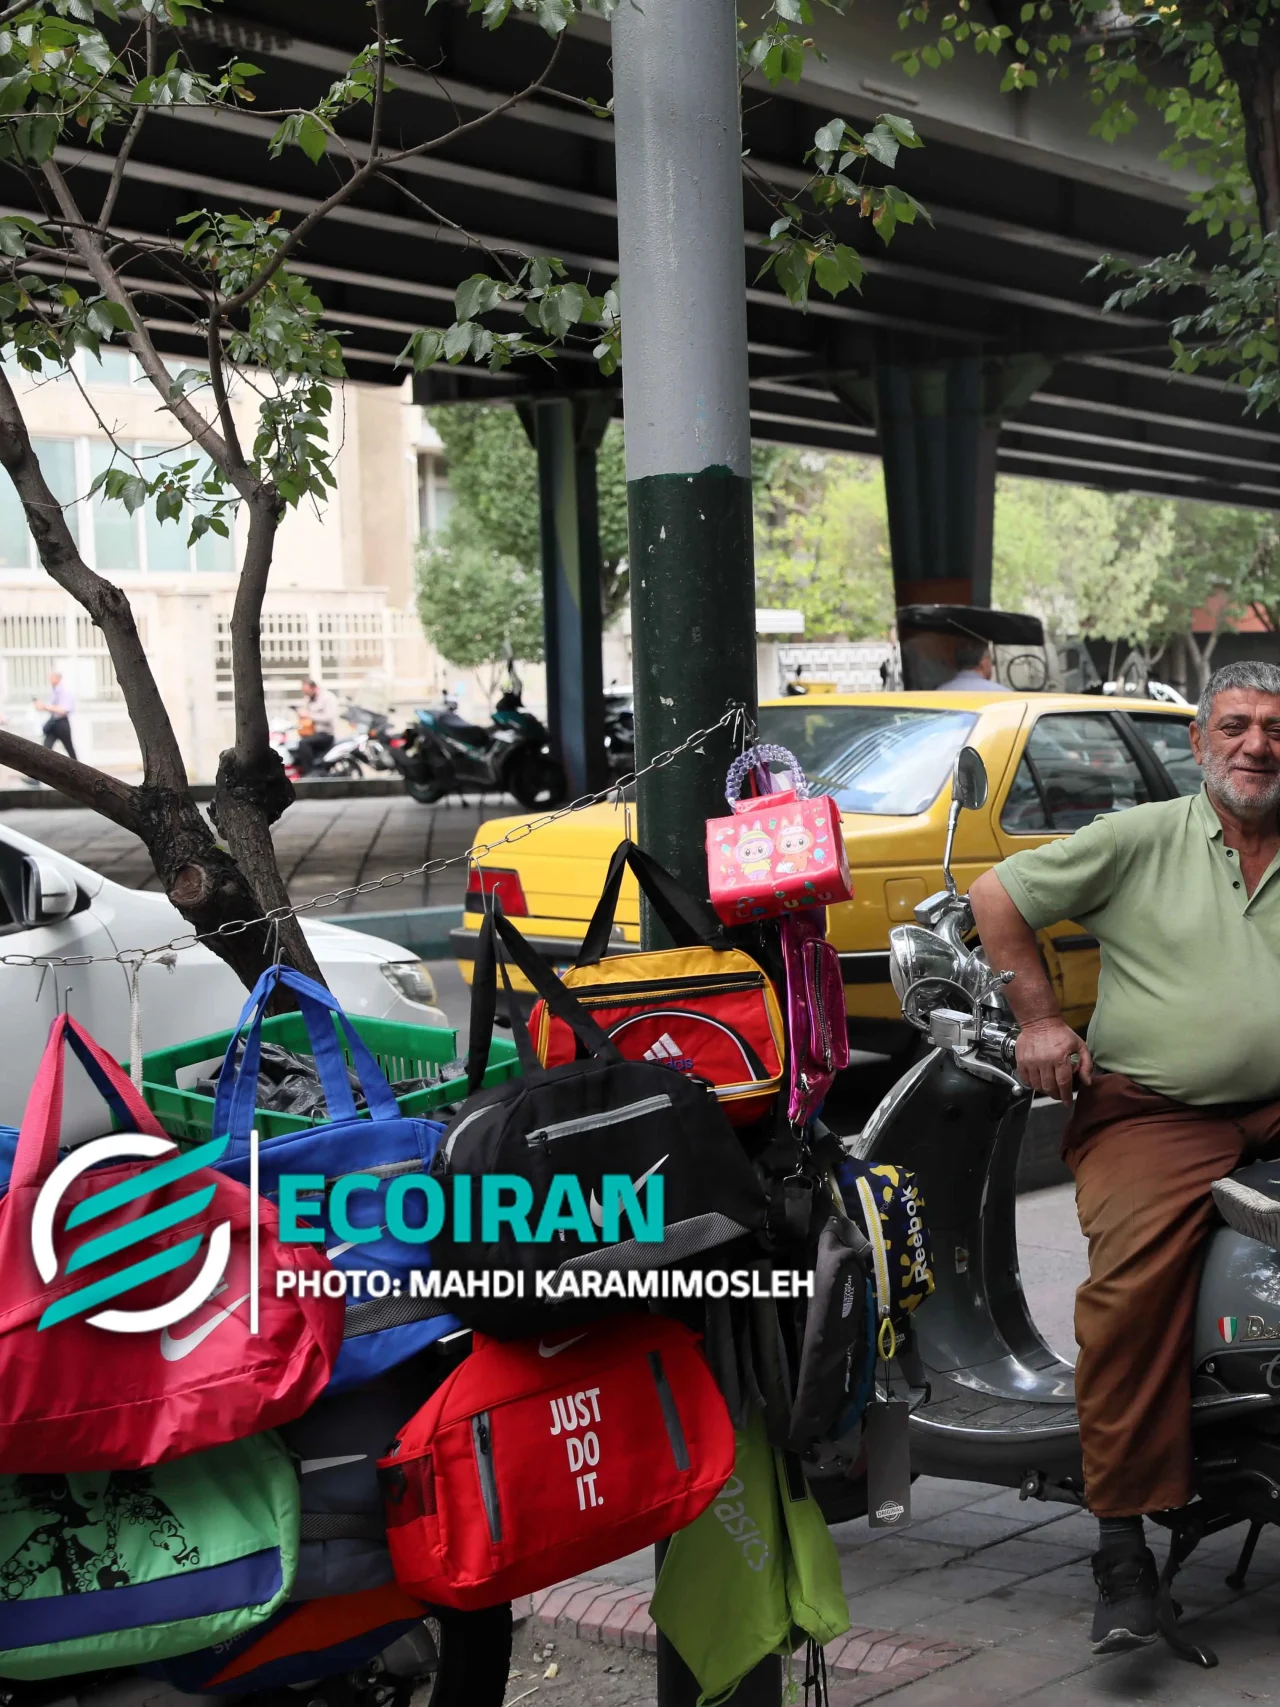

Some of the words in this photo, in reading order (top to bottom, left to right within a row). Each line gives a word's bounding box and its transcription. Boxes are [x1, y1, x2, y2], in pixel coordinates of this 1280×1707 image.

[901, 1184, 929, 1283] Reebok
[550, 1387, 602, 1436] JUST
[566, 1431, 600, 1473] DO
[576, 1471, 604, 1511] IT.
[713, 1500, 769, 1572] asics
